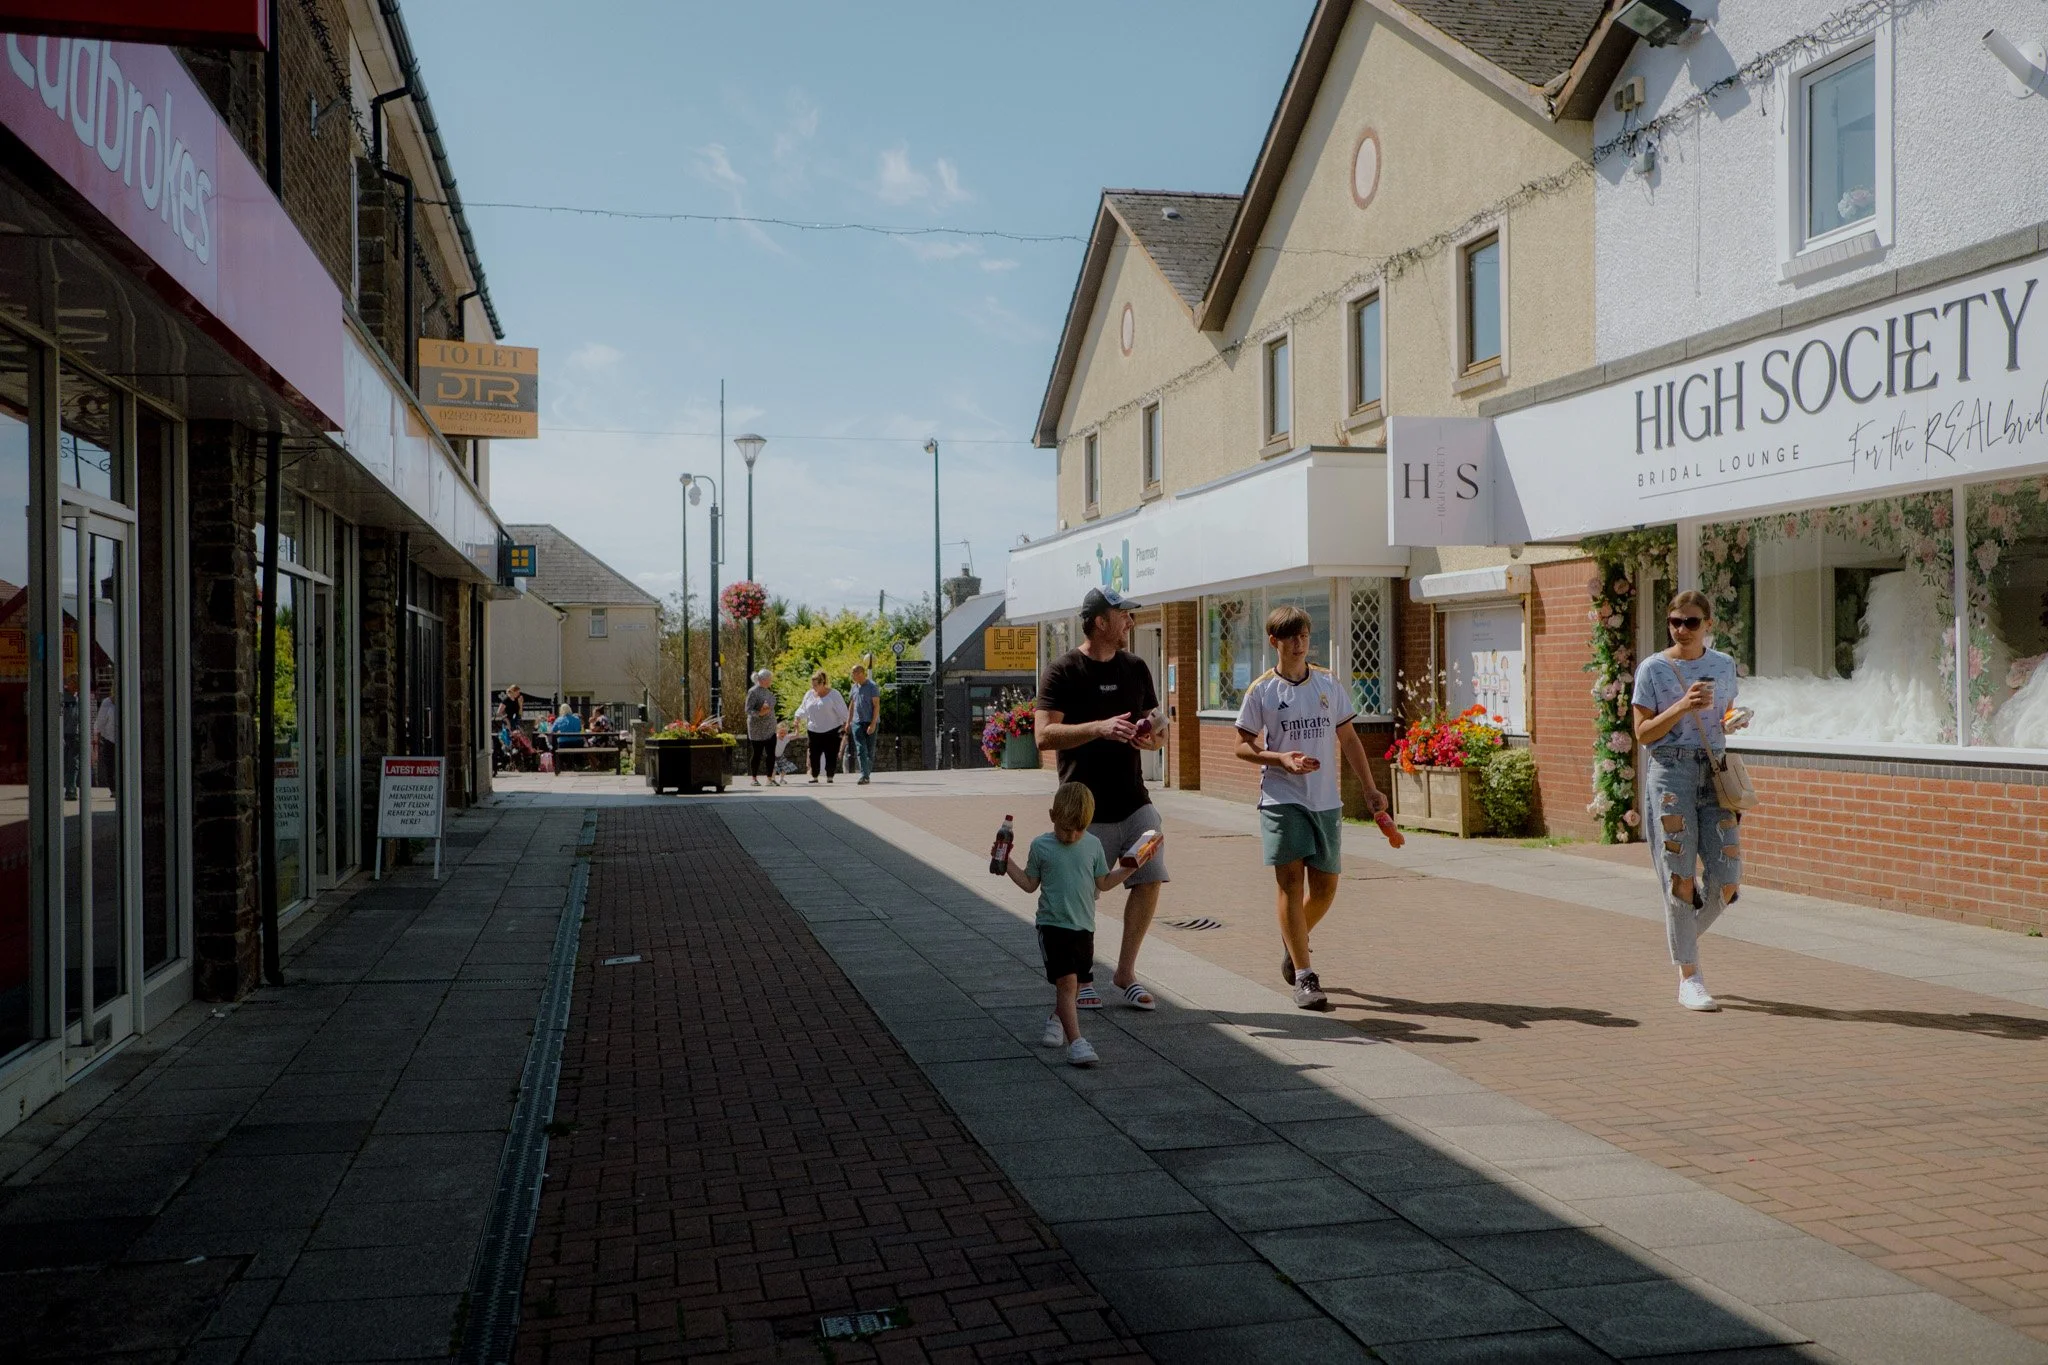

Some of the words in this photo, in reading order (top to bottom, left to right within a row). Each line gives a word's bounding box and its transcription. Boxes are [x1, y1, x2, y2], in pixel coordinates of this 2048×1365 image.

[432, 344, 469, 364] TO
[476, 347, 523, 369] LET
[1634, 360, 1745, 455] HIGH
[1760, 278, 2039, 425] SOCIETY
[437, 372, 520, 403] DTR
[1849, 419, 1883, 474] For
[1881, 410, 1915, 471] the
[1924, 398, 2002, 463] REAL
[2004, 379, 2048, 445] brid
[1637, 464, 1702, 488] BRIDAL
[1719, 444, 1801, 474] LOUNGE
[1403, 463, 1430, 499] H
[1456, 463, 1479, 500] S
[1135, 547, 1159, 562] Pharmacy
[1280, 716, 1331, 732] Emirates
[1290, 730, 1300, 741] FLY
[386, 765, 415, 775] LATEST
[416, 765, 440, 775] NEWS
[391, 784, 434, 792] REGISTERED
[408, 801, 430, 809] FLUSH
